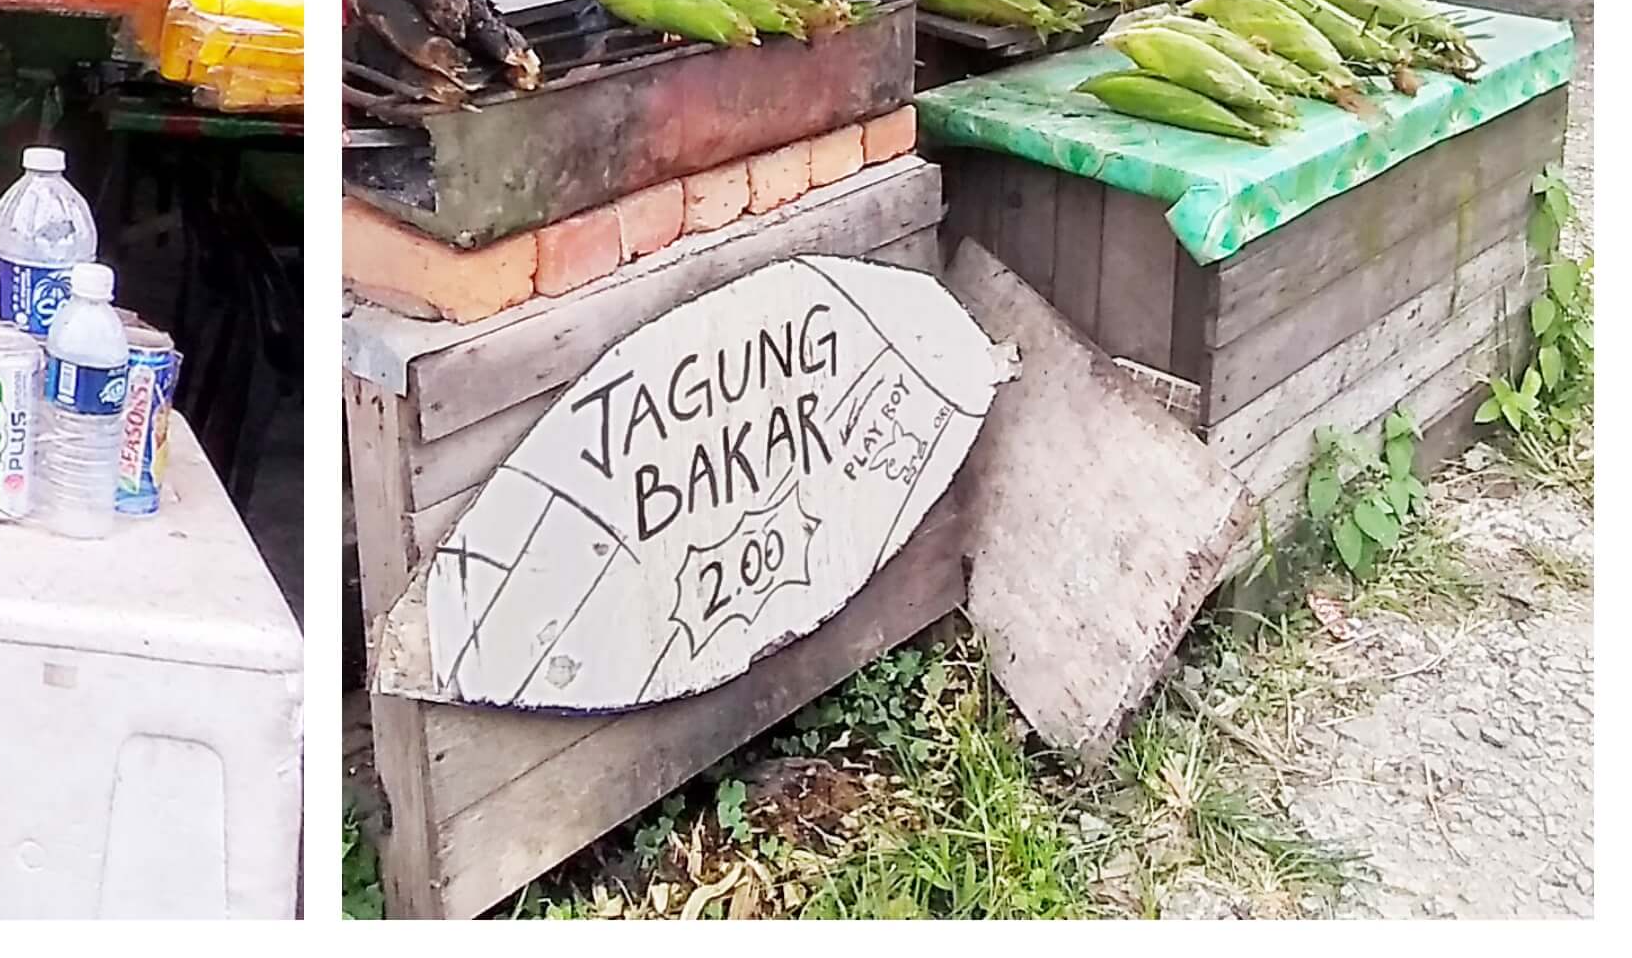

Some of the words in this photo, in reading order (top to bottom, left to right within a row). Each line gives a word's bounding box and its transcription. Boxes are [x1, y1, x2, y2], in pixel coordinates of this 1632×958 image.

[9, 411, 27, 470] PLUS
[571, 304, 837, 480] JAGUNG
[843, 420, 884, 481] PLAY
[881, 373, 910, 421] BOY
[635, 392, 832, 542] BAKAR
[699, 529, 784, 621] 2.00
